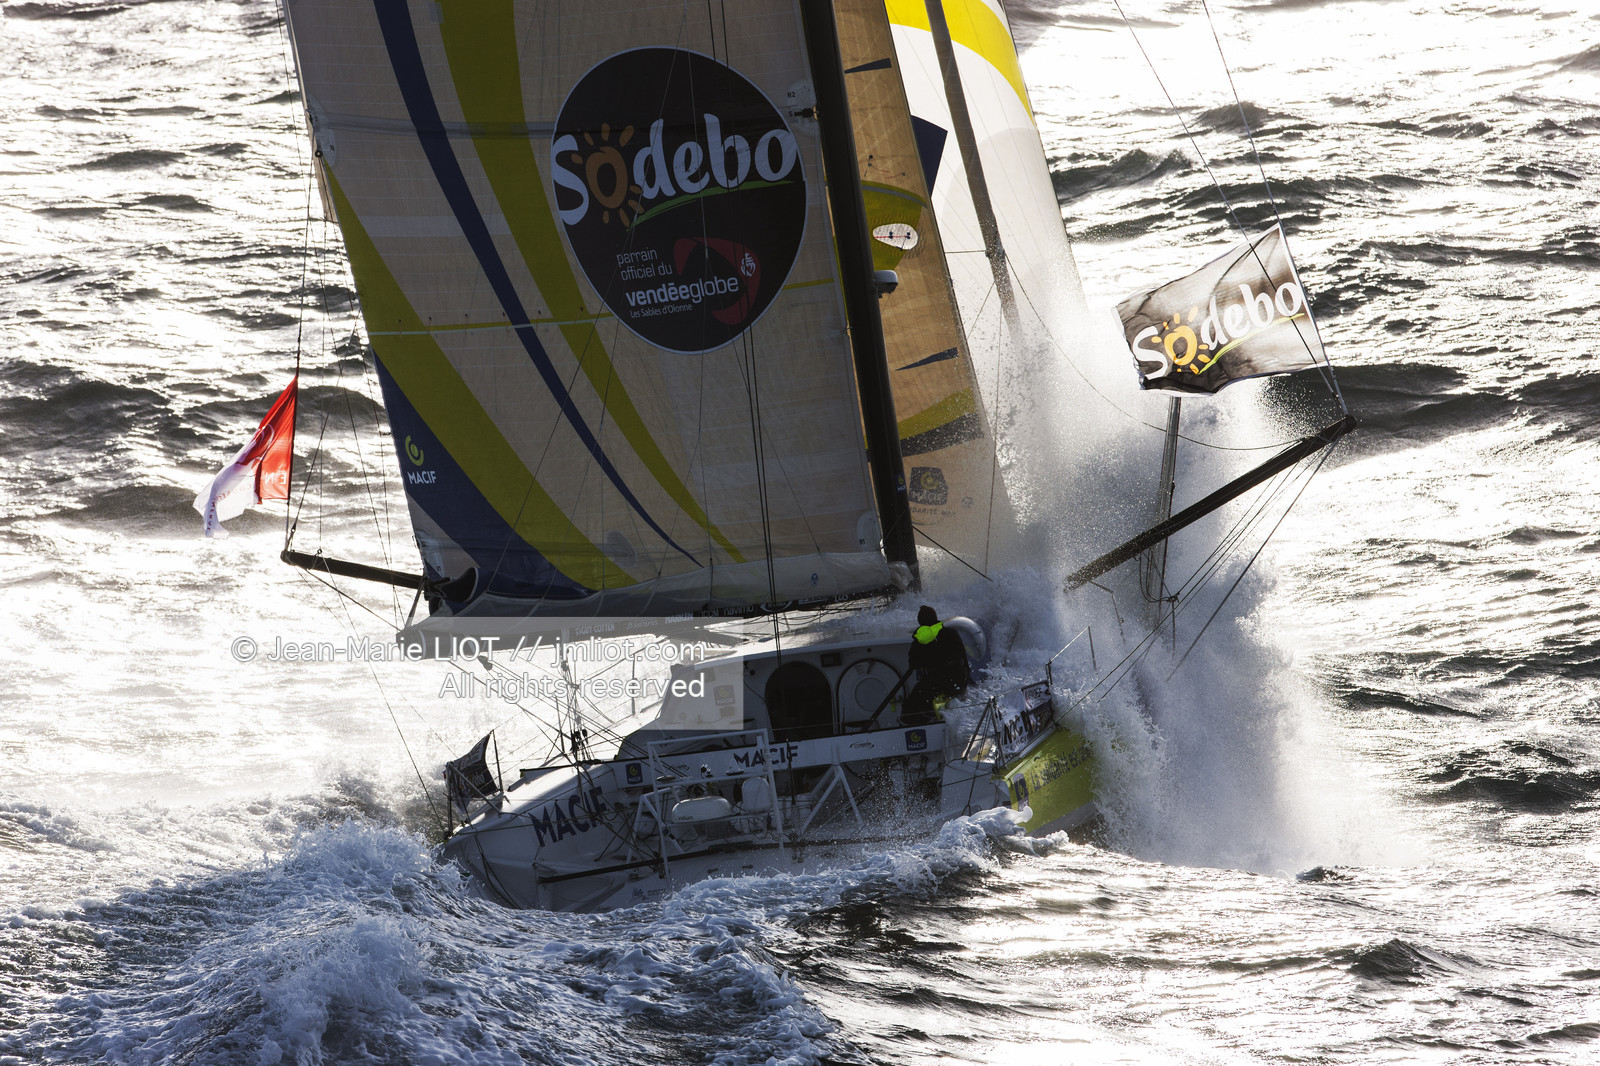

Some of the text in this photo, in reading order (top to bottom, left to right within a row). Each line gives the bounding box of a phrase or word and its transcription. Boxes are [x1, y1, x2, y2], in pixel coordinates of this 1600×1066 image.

[552, 113, 798, 225] Sodebo
[616, 247, 658, 267] parrain
[620, 262, 673, 281] officiel du
[630, 309, 641, 319] Les
[641, 306, 662, 318] Sables
[1132, 282, 1303, 379] Sodebo
[406, 470, 438, 485] MACIF
[733, 744, 799, 768] MACIF
[528, 786, 607, 847] MACIF
